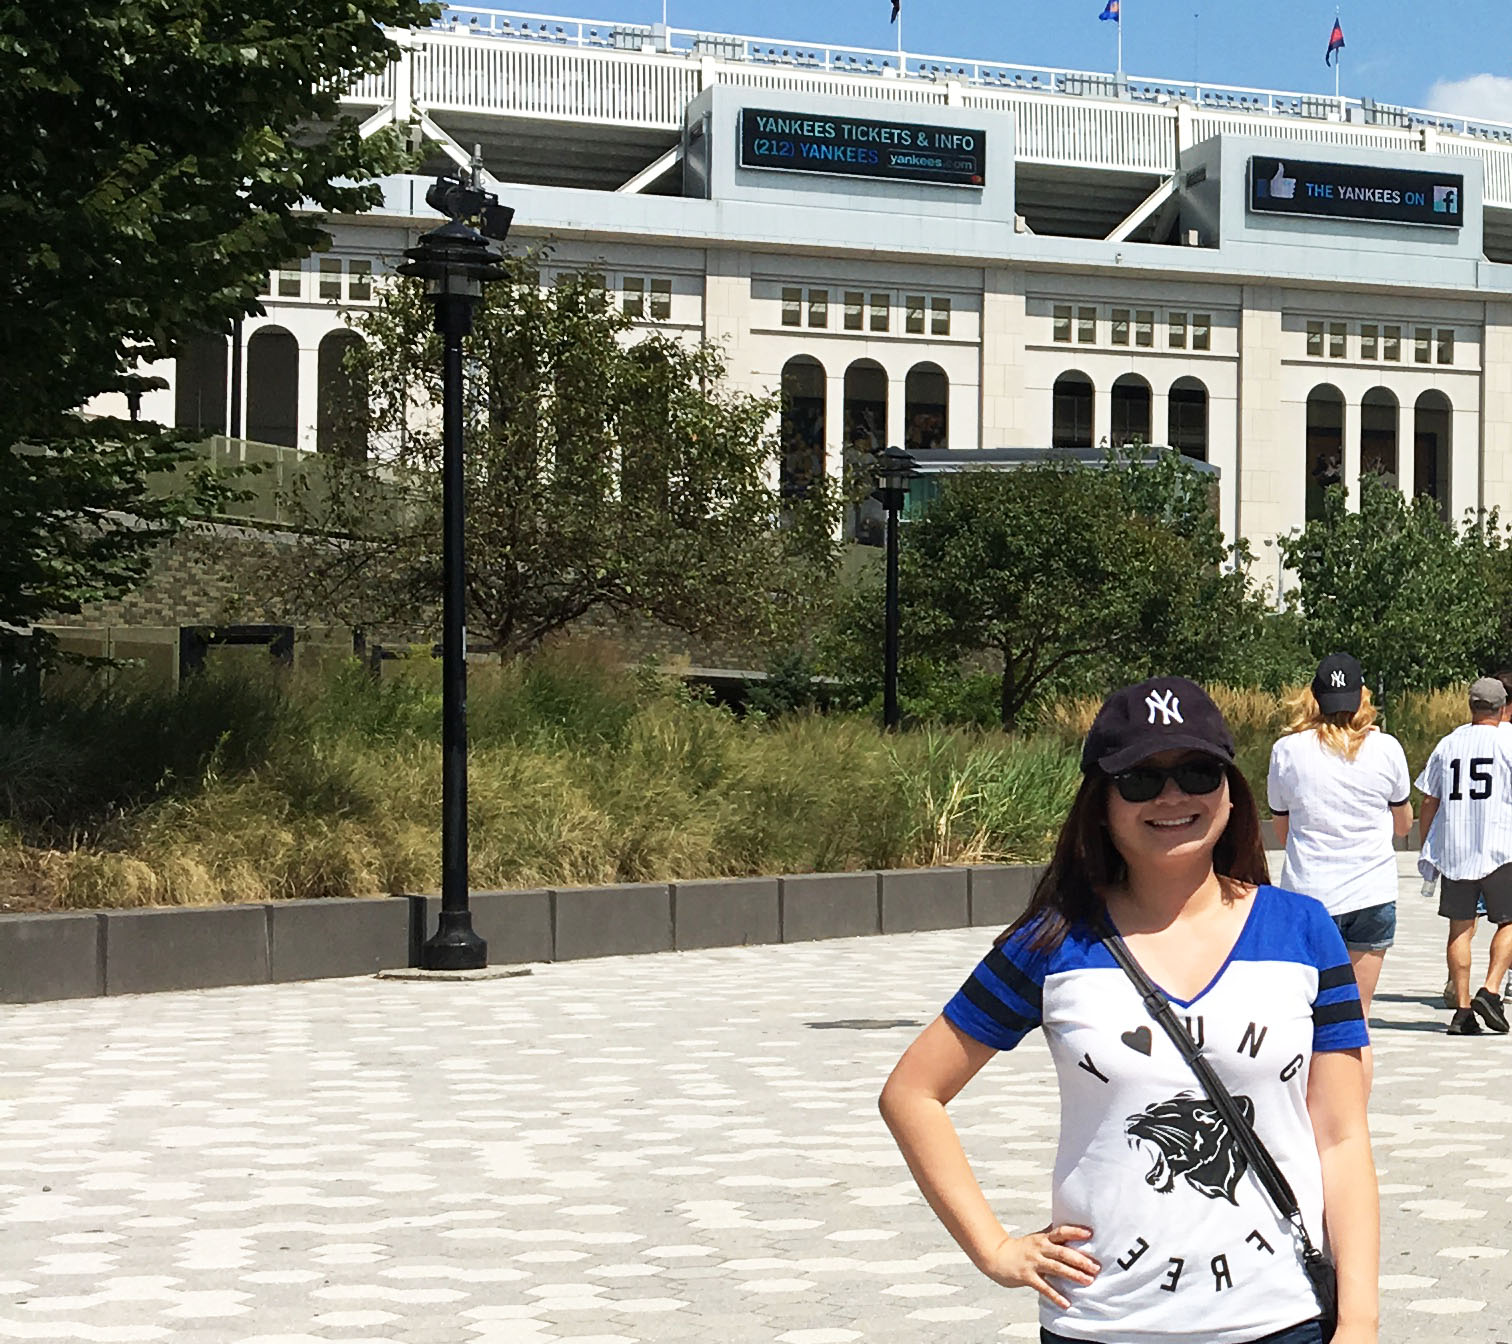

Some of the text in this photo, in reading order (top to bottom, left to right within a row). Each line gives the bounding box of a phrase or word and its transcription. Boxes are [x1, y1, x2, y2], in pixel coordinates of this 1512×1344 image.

[754, 138, 879, 164] (212) YANKEES
[757, 116, 975, 151] YANKEES TICKETS & INFO
[1305, 183, 1425, 206] THE YANKEES ON
[1144, 689, 1184, 725] NY
[1448, 757, 1494, 801] 15
